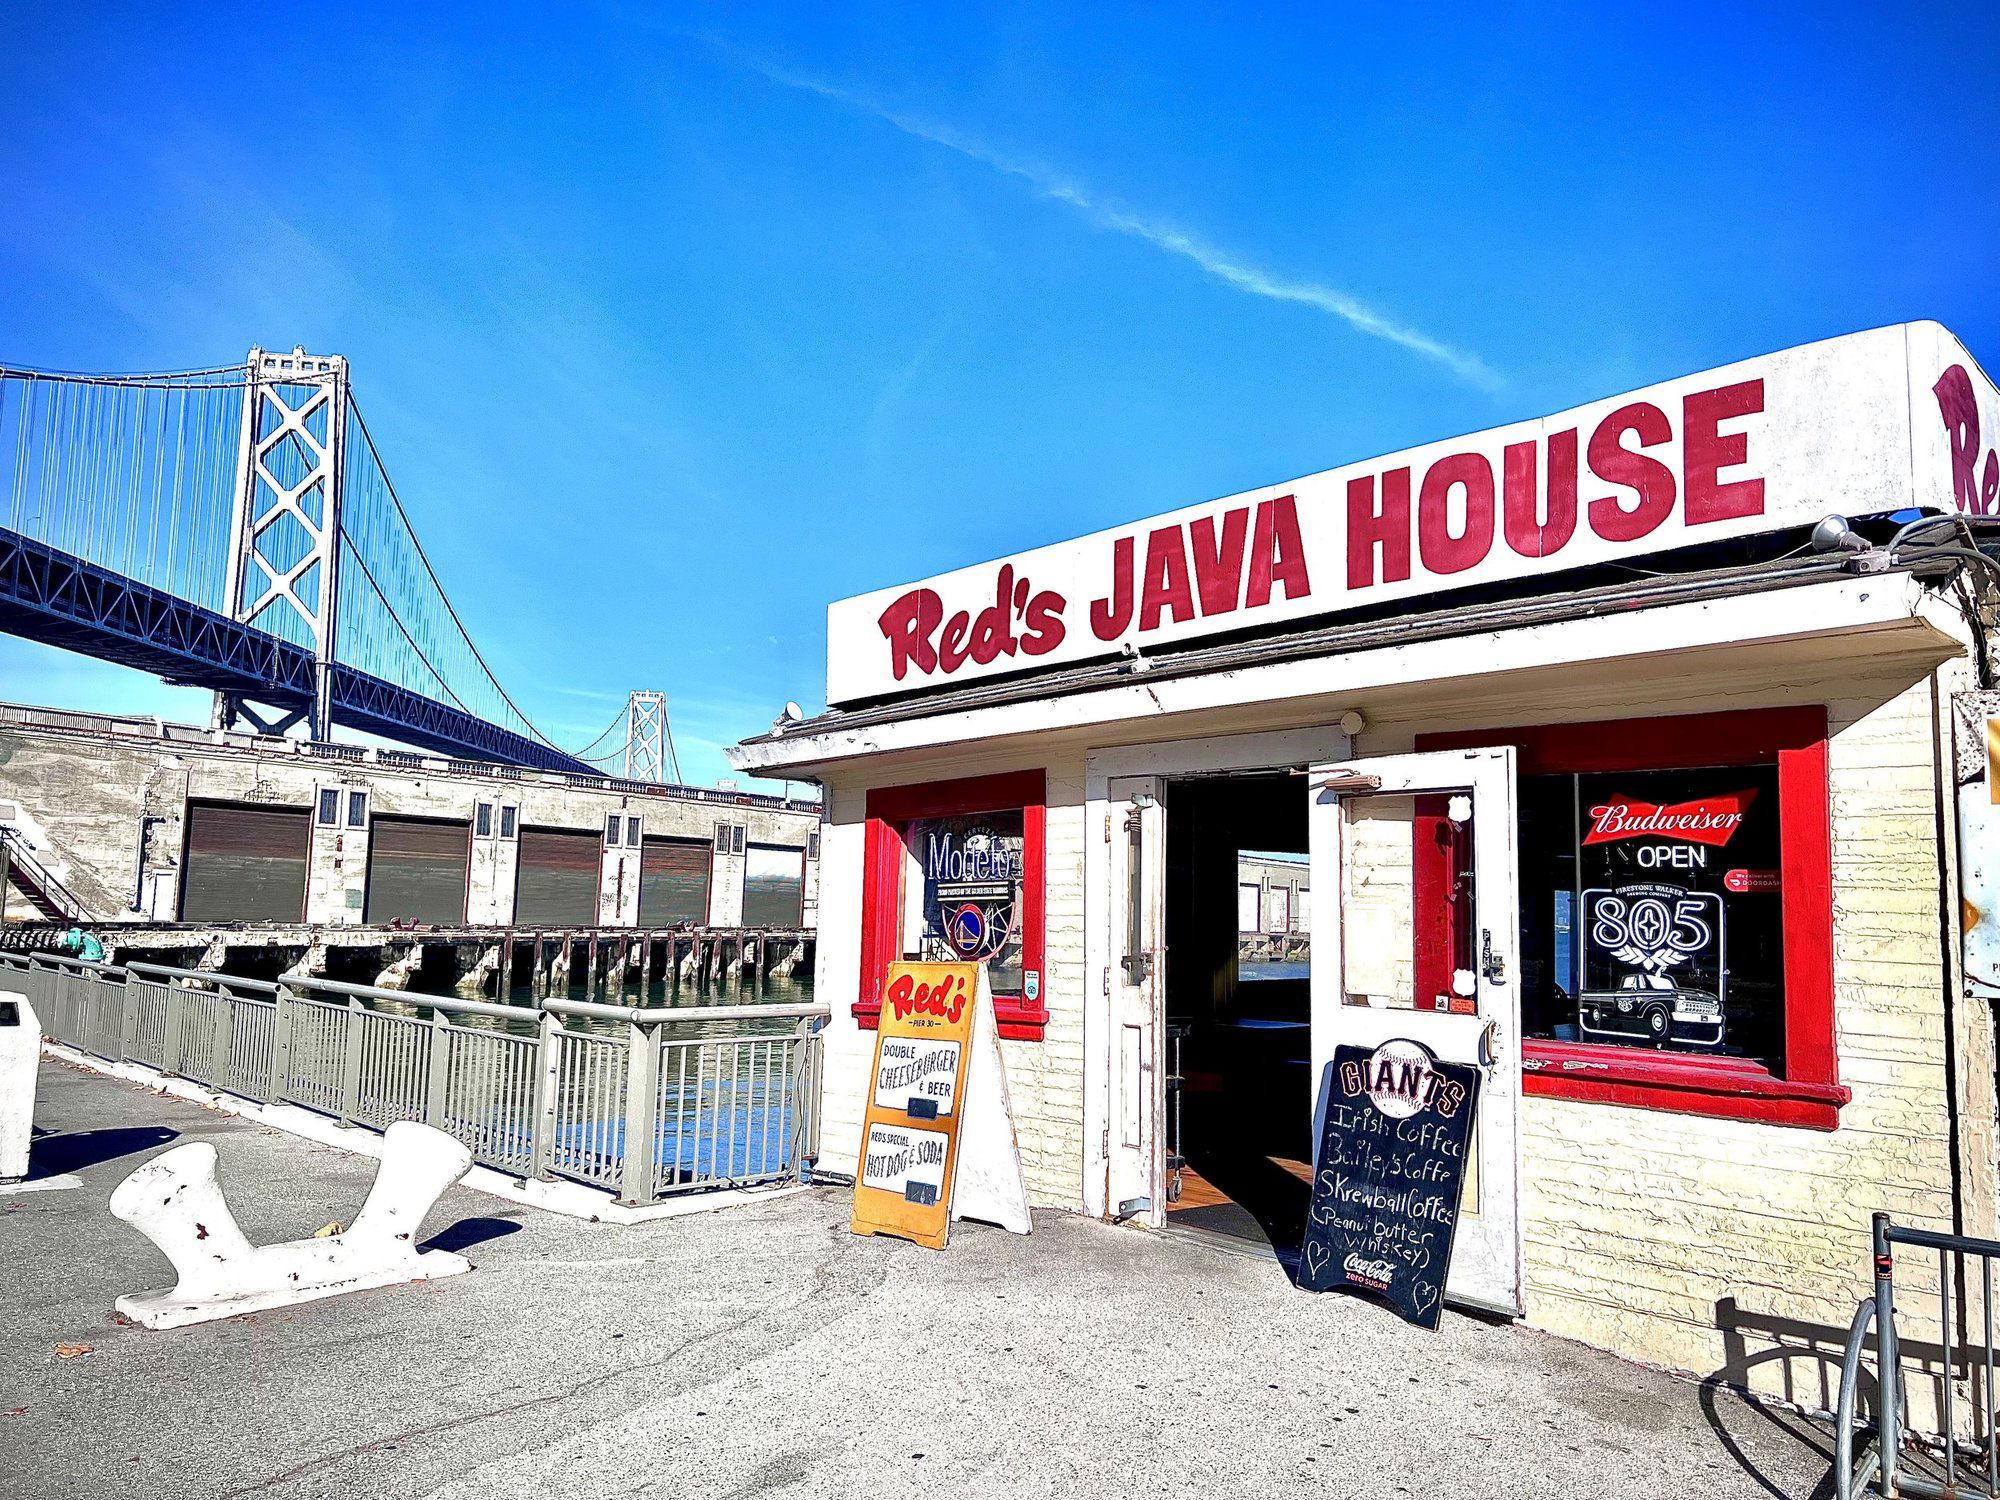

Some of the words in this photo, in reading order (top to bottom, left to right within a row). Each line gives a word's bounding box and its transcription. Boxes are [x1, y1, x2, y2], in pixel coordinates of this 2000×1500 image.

[877, 563, 1066, 681] Red's
[1090, 494, 1311, 641] JAVA
[1346, 378, 1764, 589] HOUSE
[1589, 804, 1743, 834] Budweiser
[928, 833, 1010, 880] Modelo
[1637, 846, 1706, 868] OPEN
[1615, 885, 1653, 895] FIRESTONE
[1655, 885, 1684, 898] WALKER
[1593, 897, 1713, 951] 805
[887, 975, 966, 1024] Red's
[884, 1044, 916, 1059] DOUBLE
[879, 1049, 956, 1090] CHEESEBURGER
[928, 1082, 951, 1097] BEER
[1340, 1059, 1465, 1118] GIANTS
[1329, 1103, 1389, 1137] Irish
[887, 1133, 909, 1147] SPECIAL
[866, 1153, 887, 1178] HOT
[887, 1149, 908, 1178] DOG
[918, 1140, 943, 1166] SODA
[1373, 1215, 1434, 1244] butter
[1345, 1271, 1363, 1283] zero
[1364, 1278, 1388, 1290] SUGAR
